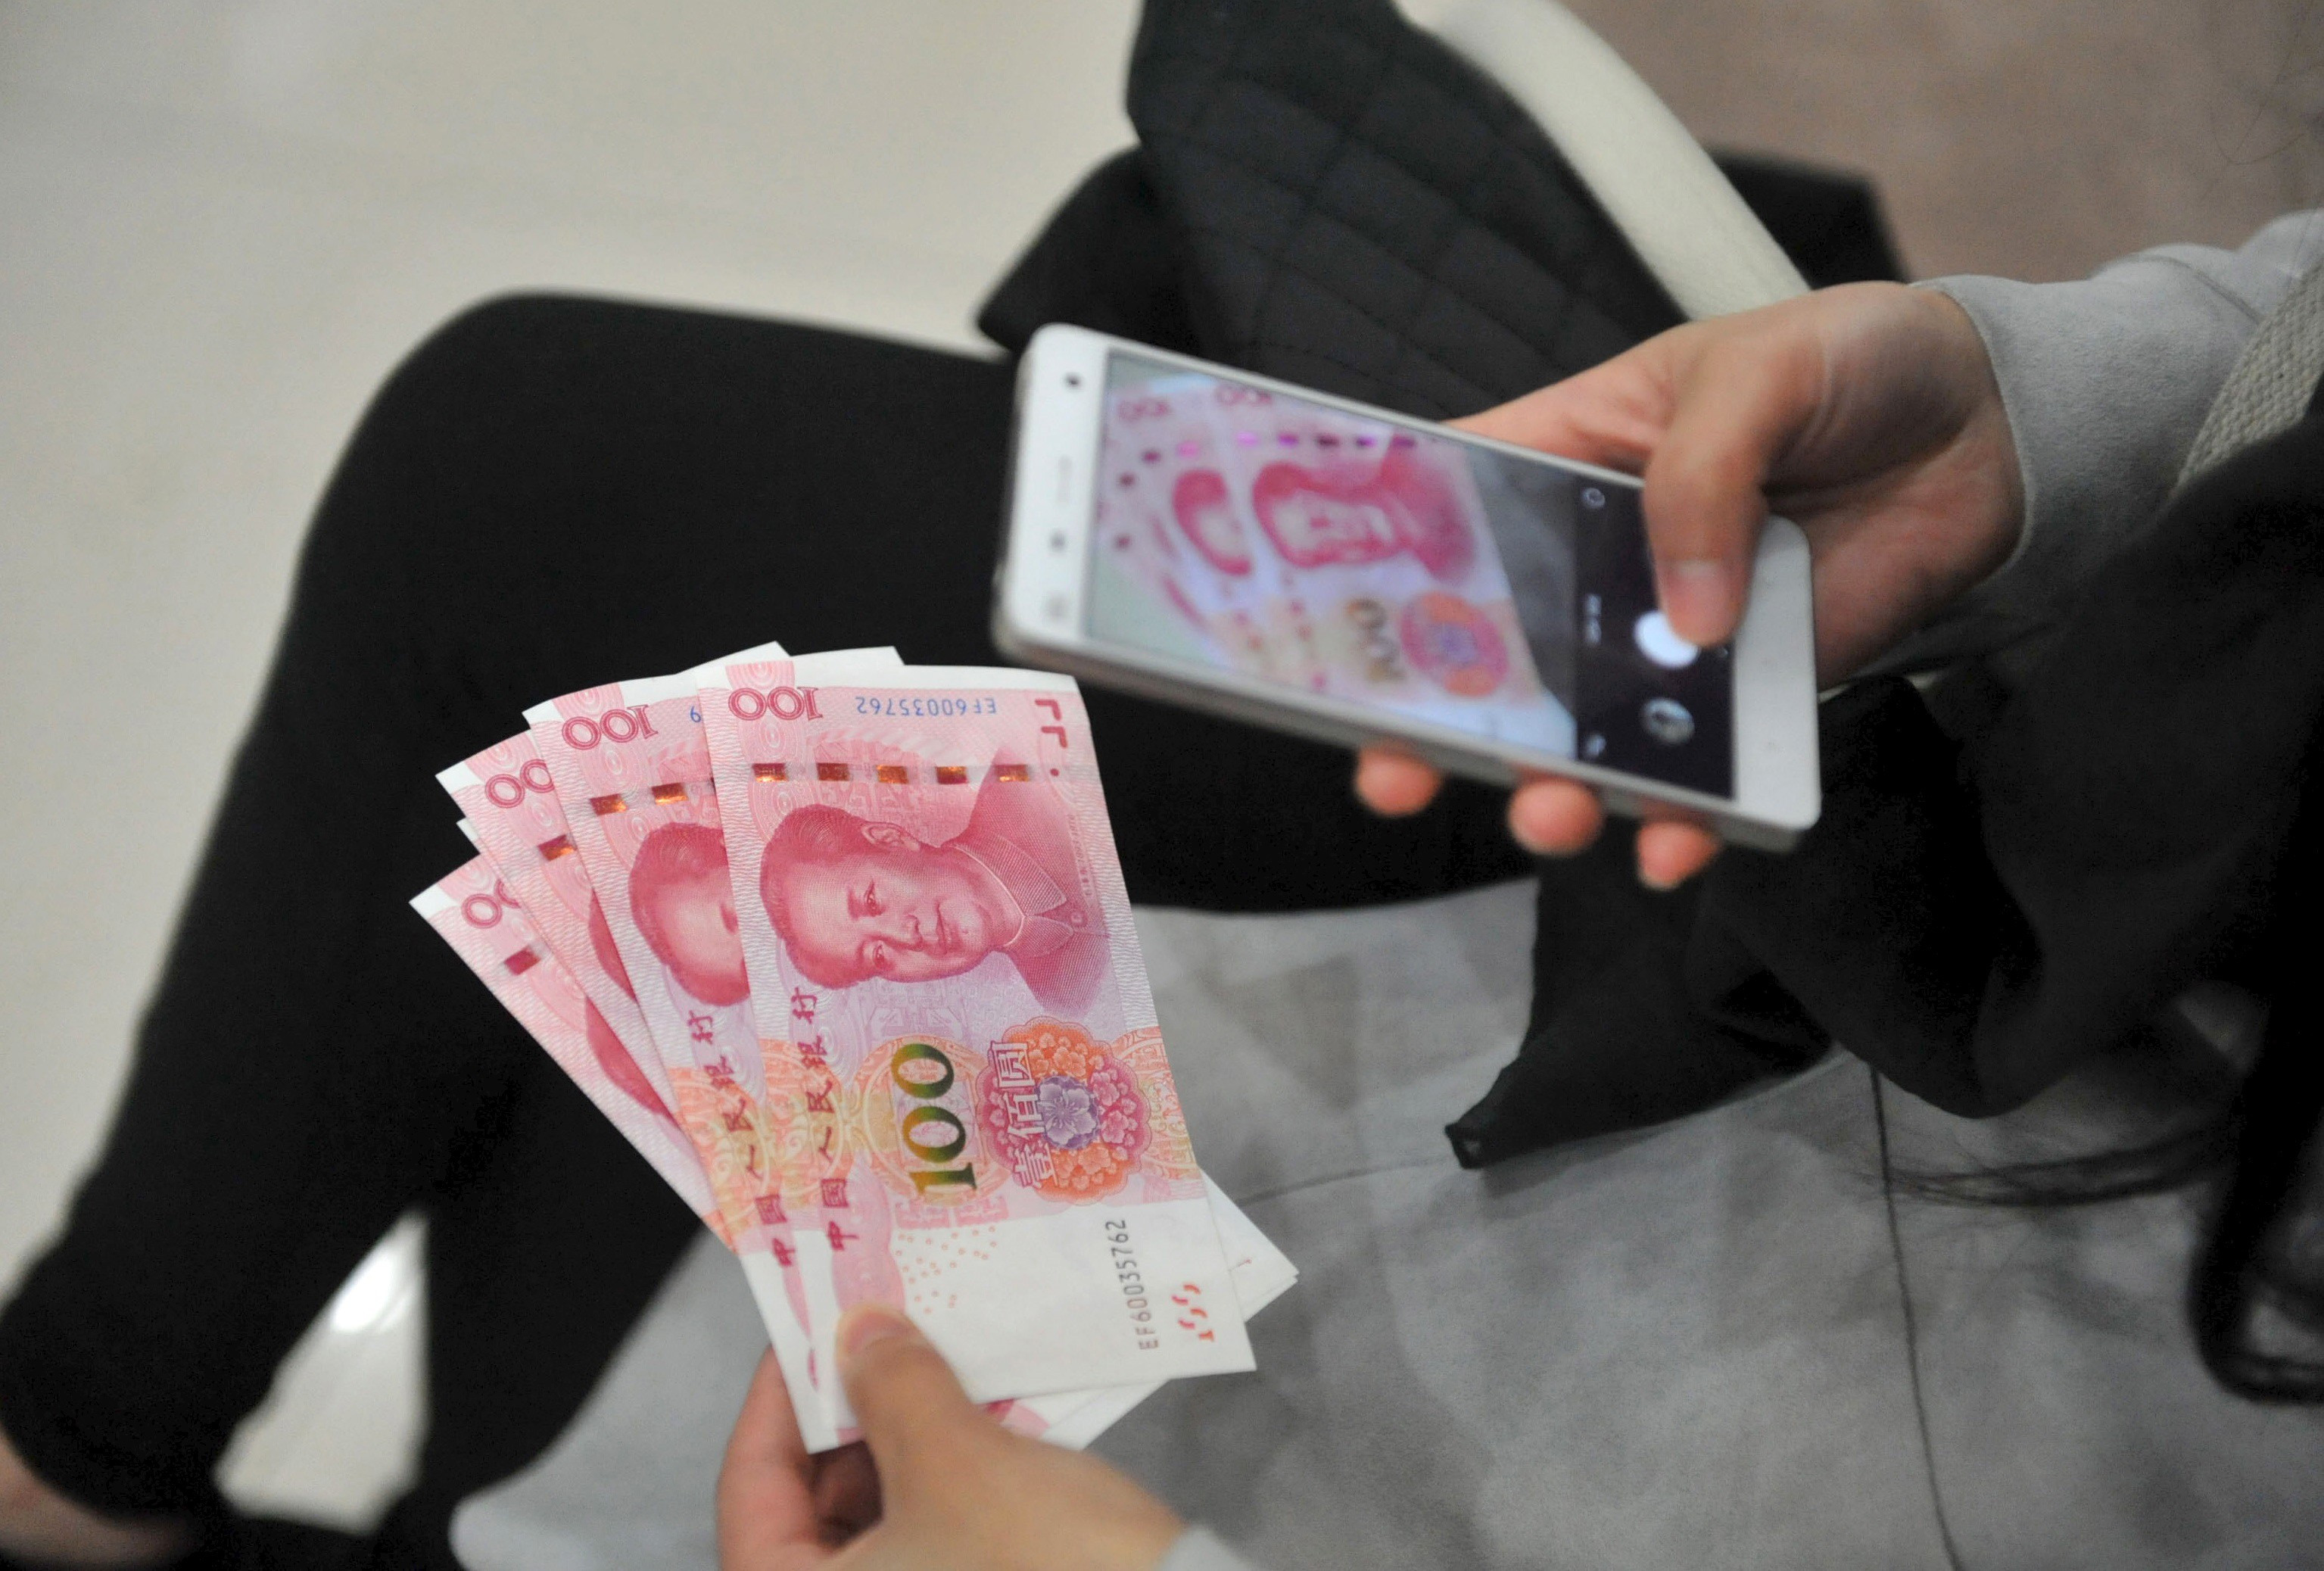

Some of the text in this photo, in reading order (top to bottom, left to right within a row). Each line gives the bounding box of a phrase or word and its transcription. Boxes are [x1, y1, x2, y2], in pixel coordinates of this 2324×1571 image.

[562, 704, 659, 750] 100
[728, 686, 824, 722] 100
[855, 696, 997, 715] EF60035762
[484, 759, 556, 809] 00
[687, 1010, 796, 1267] 中国人民银行
[791, 987, 858, 1251] 中国人民银行
[890, 1043, 977, 1197] 100
[987, 1040, 1060, 1188] 壹佰圆
[1105, 1218, 1159, 1351] EF60035762
